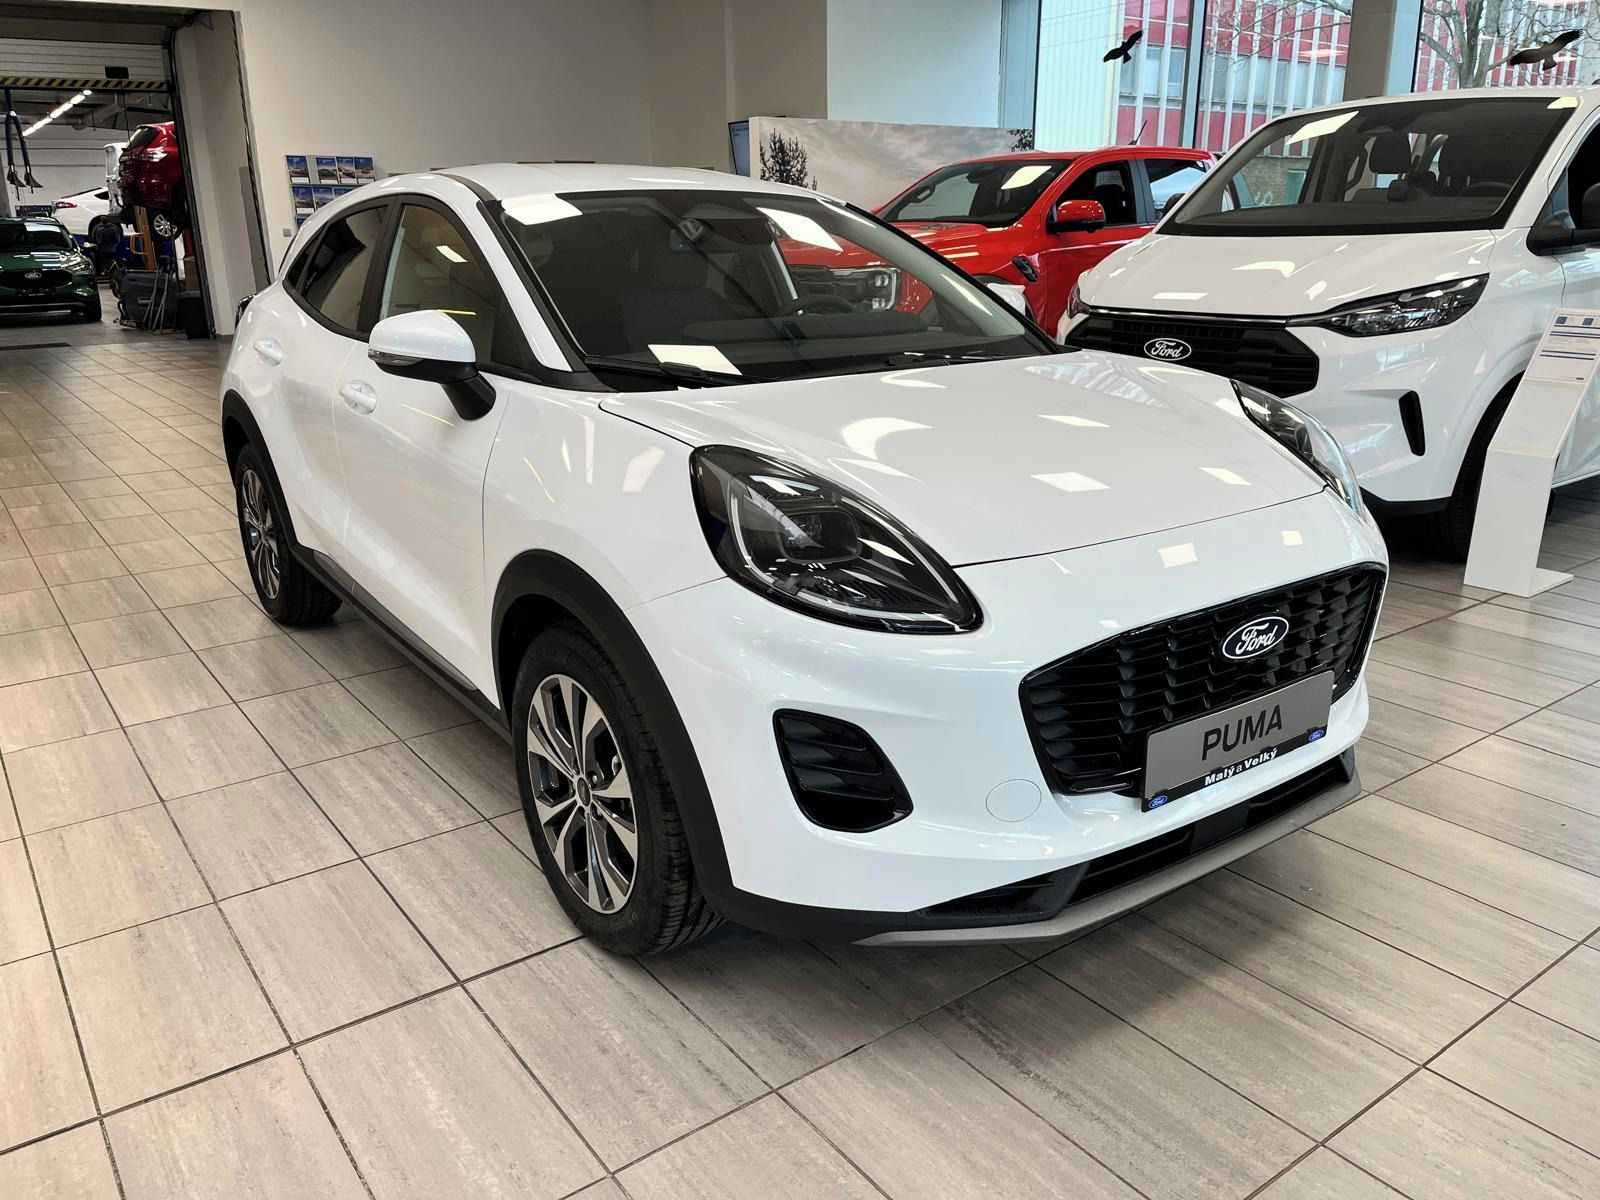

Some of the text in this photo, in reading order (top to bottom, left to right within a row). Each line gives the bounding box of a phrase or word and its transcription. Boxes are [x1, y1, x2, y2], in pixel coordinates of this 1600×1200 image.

[1151, 341, 1183, 357] Ford
[1236, 622, 1278, 655] Ford
[1202, 704, 1282, 761] PUMA
[1205, 748, 1277, 786] Malý a Velký
